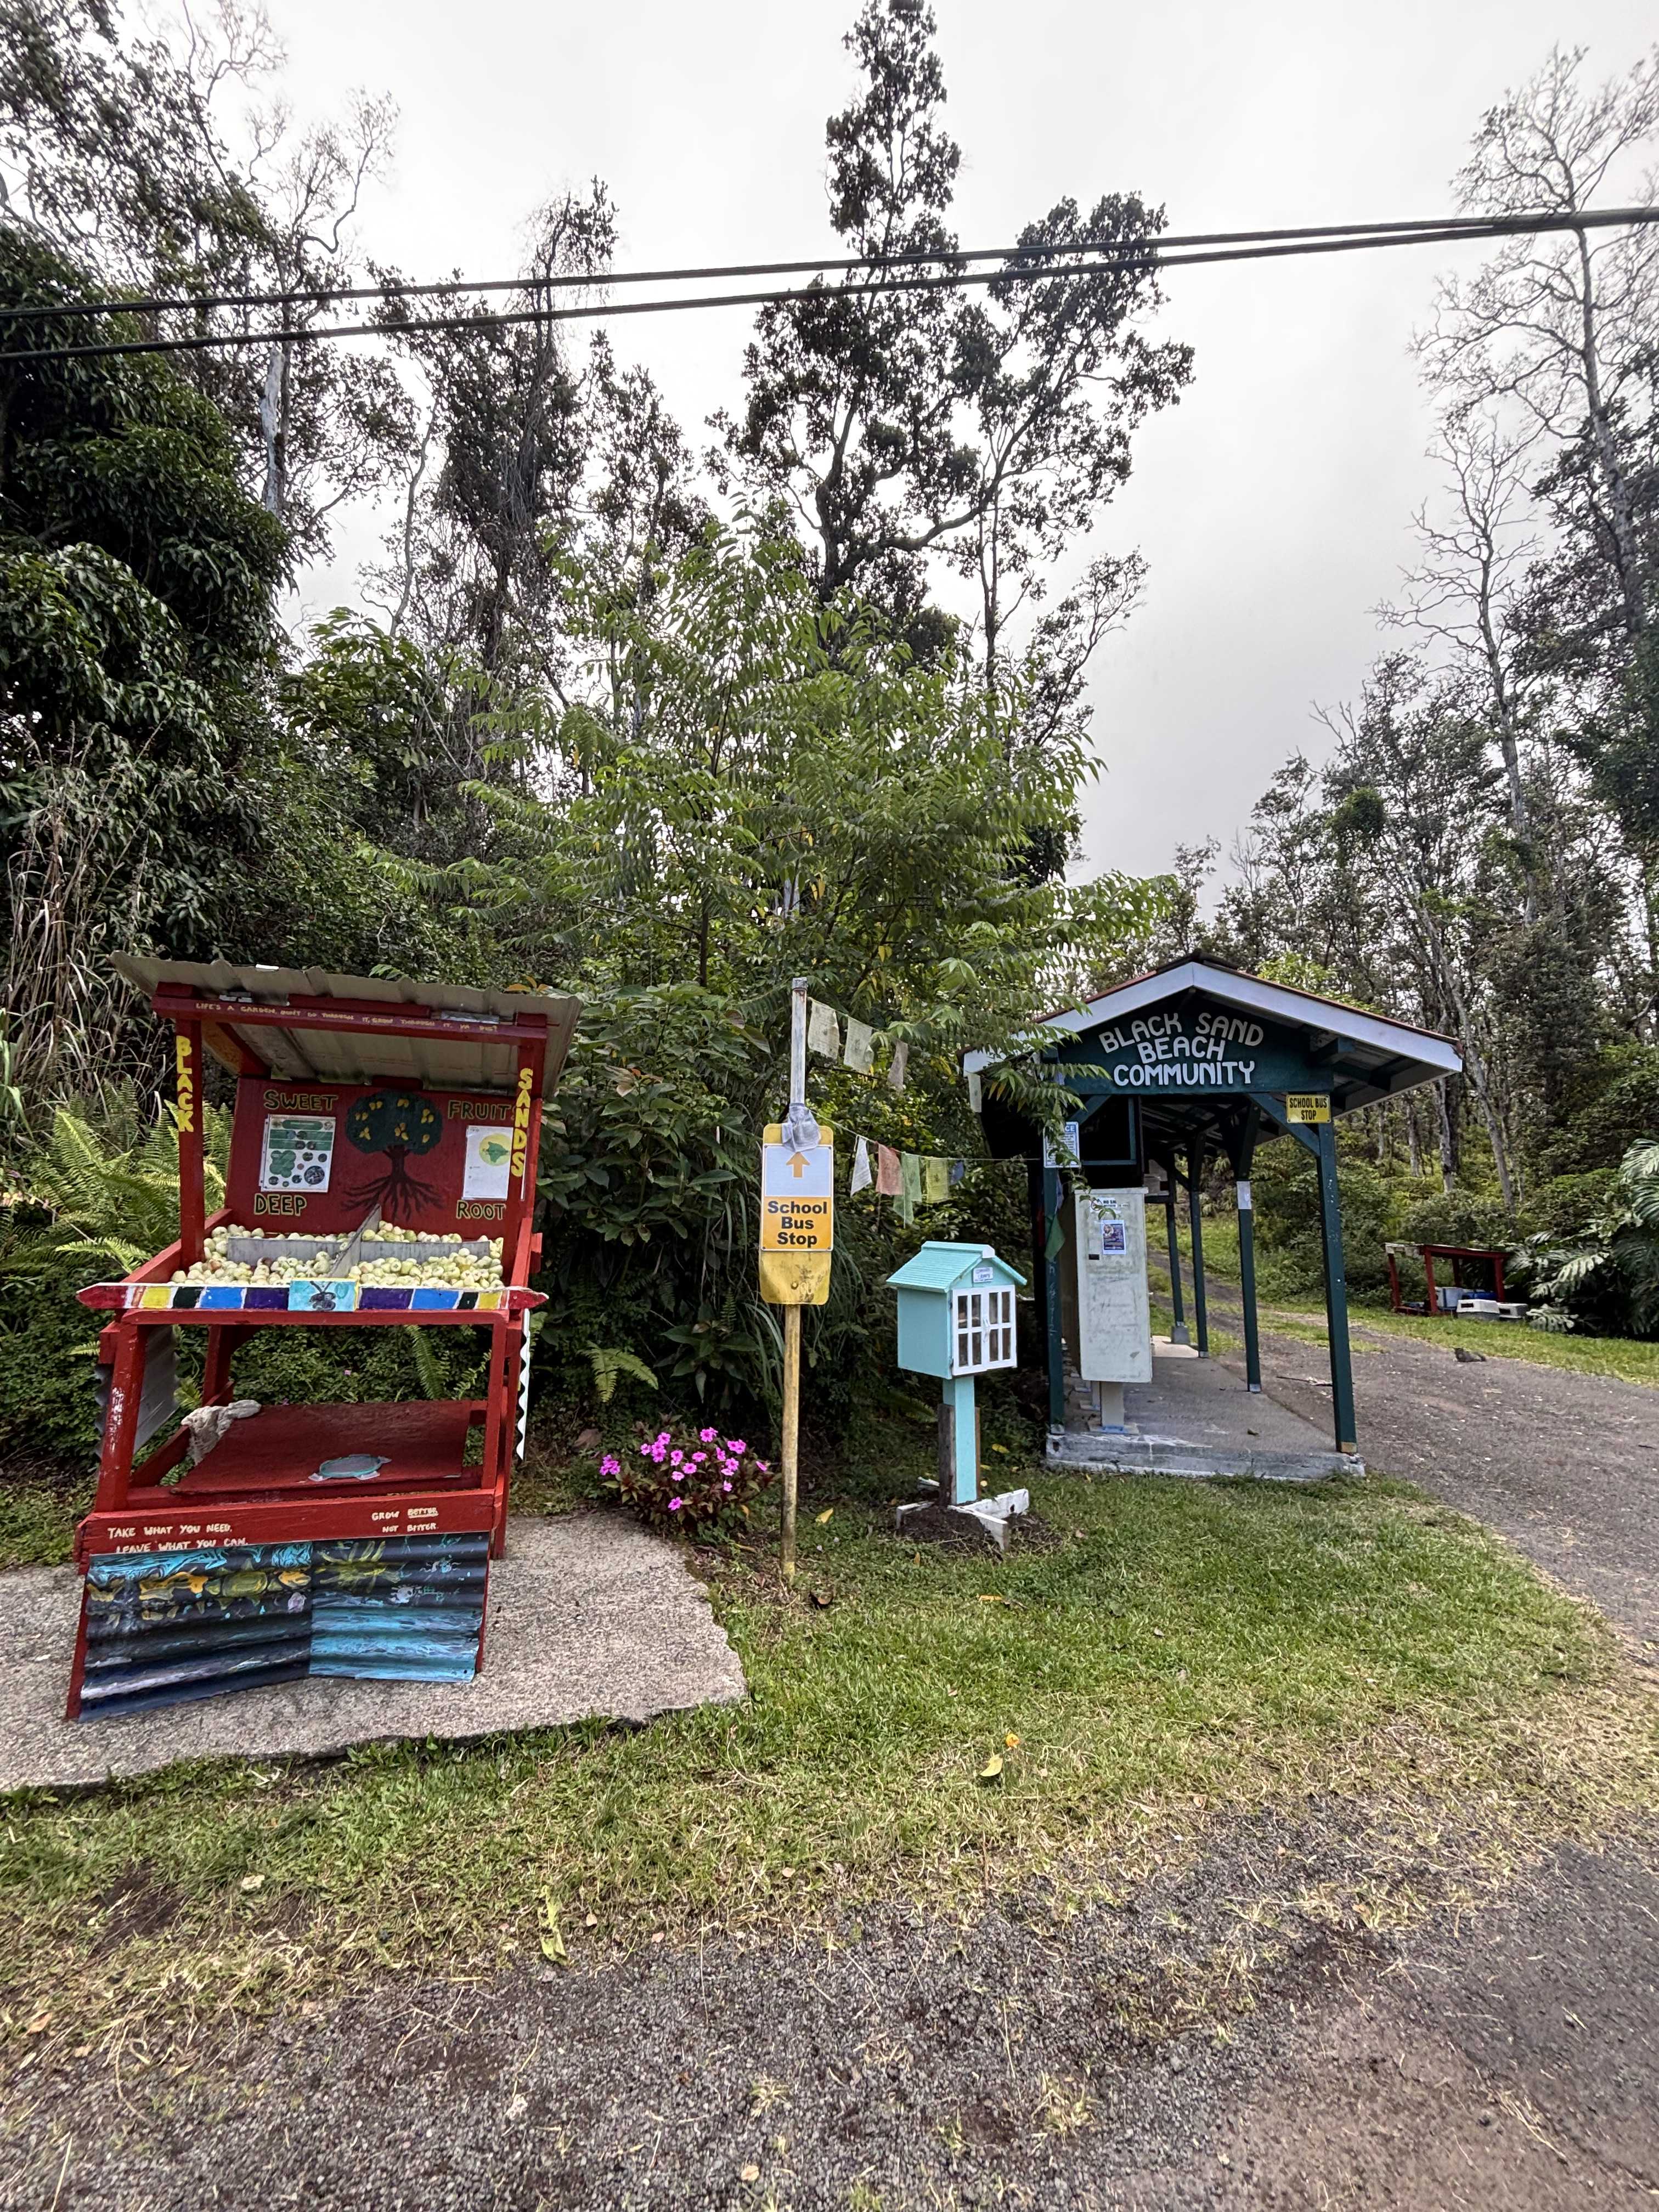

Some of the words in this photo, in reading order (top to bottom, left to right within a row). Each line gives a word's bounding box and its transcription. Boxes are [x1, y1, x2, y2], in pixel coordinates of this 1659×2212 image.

[195, 1002, 221, 1011] LIFE'S
[1098, 1013, 1182, 1053] BLACK
[1195, 1012, 1264, 1047] SAND
[1137, 1036, 1226, 1064] BEACH
[1113, 1060, 1255, 1086] COMMUNITY
[176, 1035, 194, 1132] BLACK
[263, 1089, 338, 1111] SWEET
[1289, 1097, 1313, 1108] SCHOOL
[1315, 1097, 1327, 1108] BUS
[511, 1068, 534, 1177] SANDS
[1301, 1109, 1317, 1120] STOP
[254, 1193, 307, 1216] DEEP
[456, 1199, 507, 1220] ROOT
[768, 1200, 827, 1214] School
[781, 1216, 815, 1229] Bus
[777, 1232, 817, 1248] Stop
[371, 1511, 400, 1521] GROW
[108, 1527, 136, 1539] TAKE
[143, 1526, 173, 1536] WHAT
[179, 1524, 200, 1535] YOU
[206, 1523, 233, 1533] NEED.
[116, 1543, 151, 1553] LEAVE
[158, 1541, 191, 1551] WHAT
[196, 1539, 217, 1548] YOU
